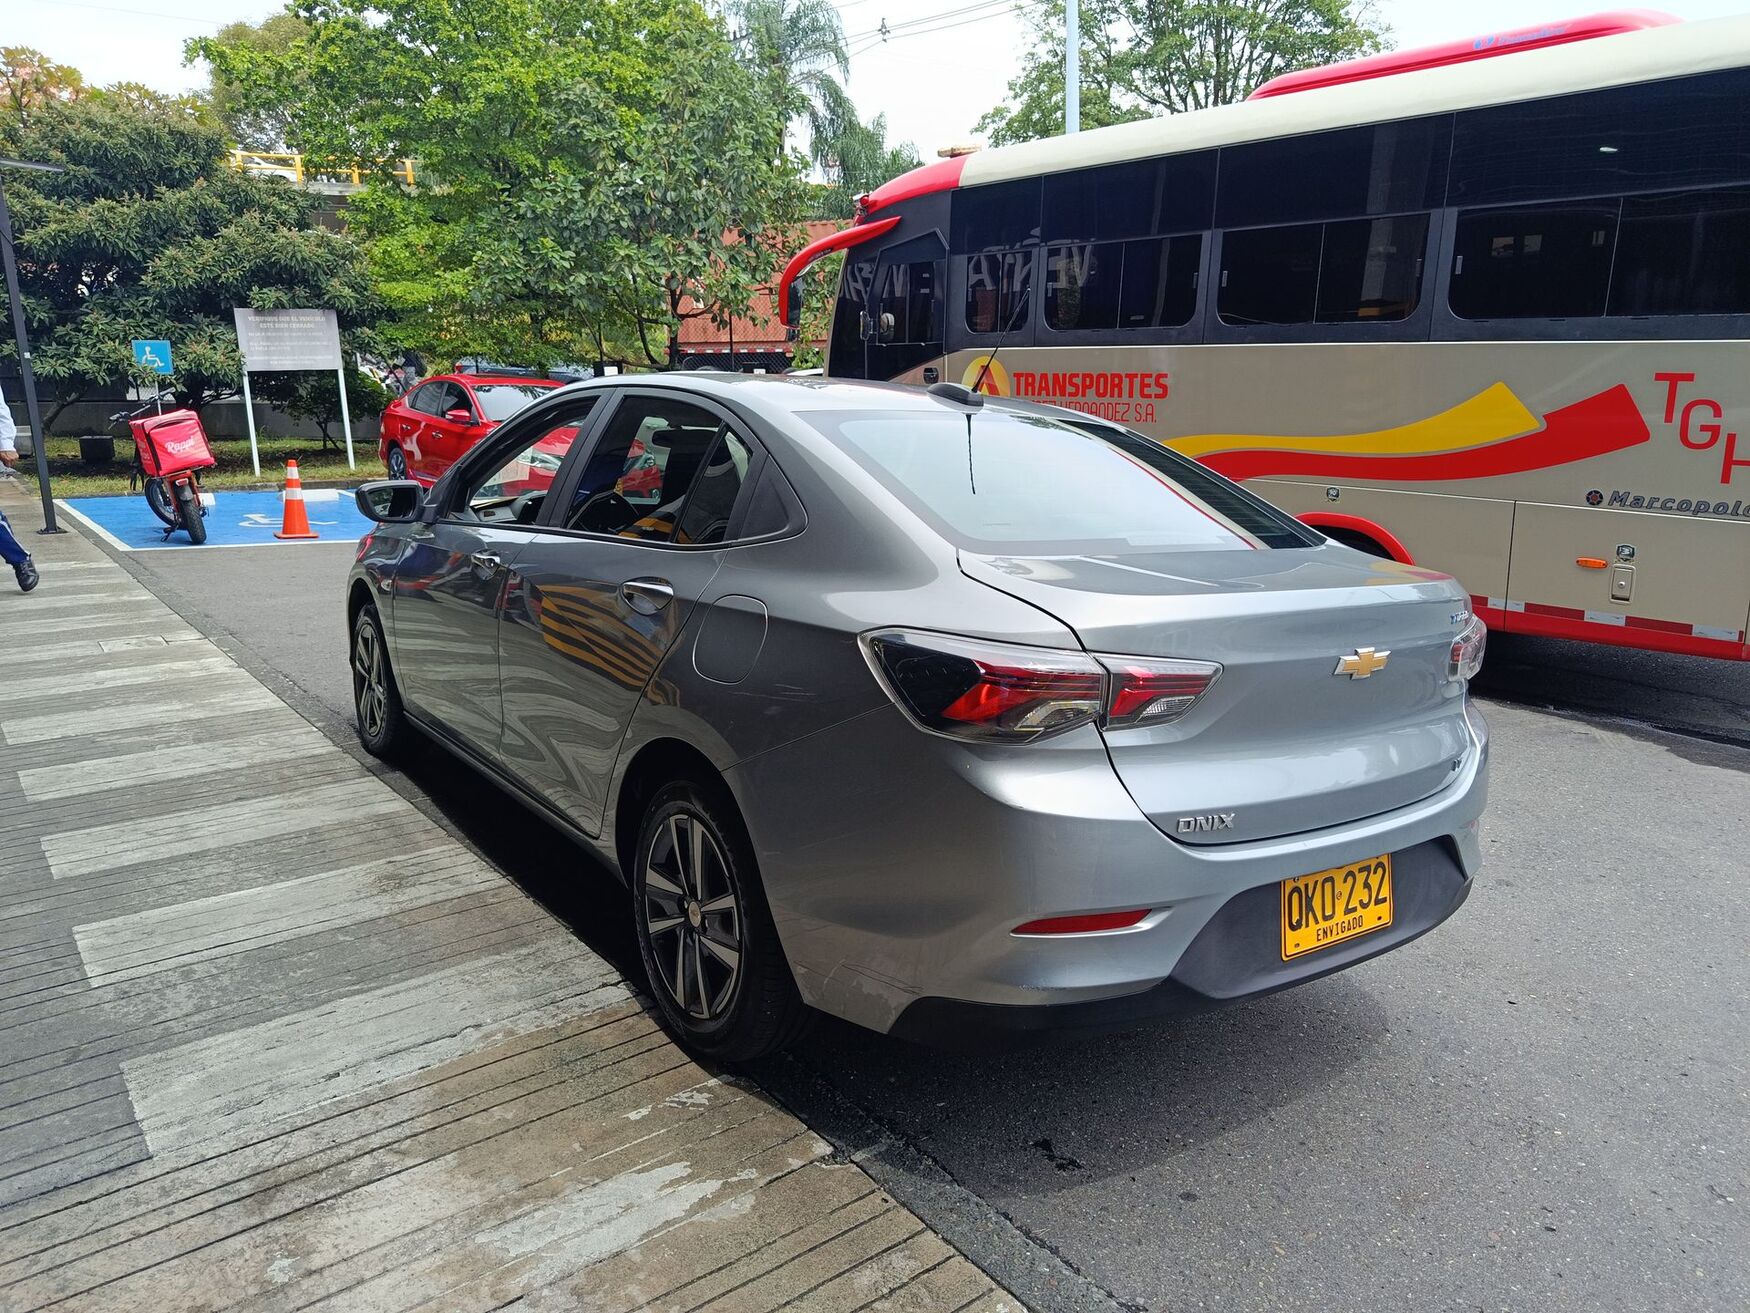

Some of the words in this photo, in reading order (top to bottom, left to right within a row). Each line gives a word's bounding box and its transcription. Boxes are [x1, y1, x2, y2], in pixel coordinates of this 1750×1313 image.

[1012, 372, 1169, 399] TRANSPORTES
[1134, 402, 1157, 424] S.A.
[165, 436, 194, 454] Rappi
[1177, 813, 1235, 833] ONIX
[1343, 860, 1389, 917] 232
[1316, 914, 1365, 942] ENVIGADO
